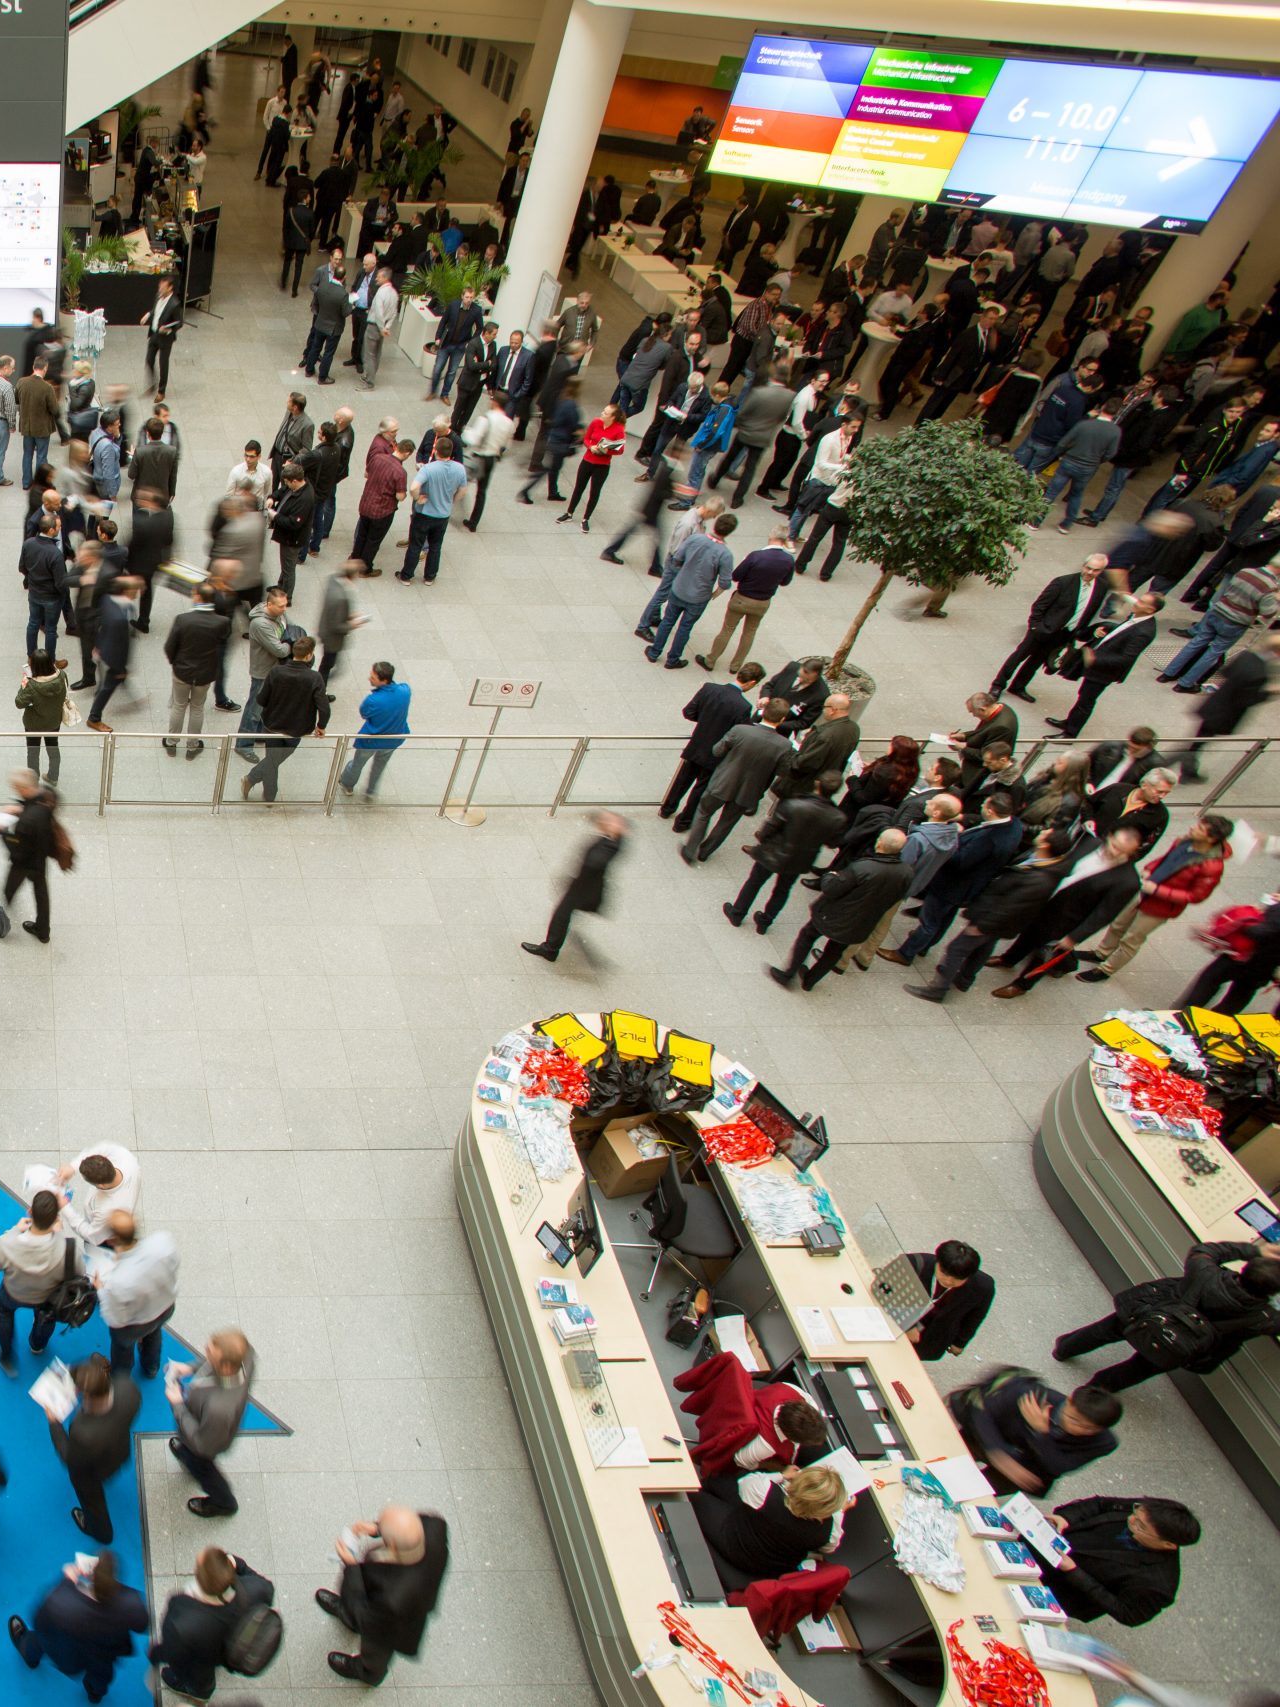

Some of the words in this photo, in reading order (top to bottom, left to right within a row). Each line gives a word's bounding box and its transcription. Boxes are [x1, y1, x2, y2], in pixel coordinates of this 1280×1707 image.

[860, 95, 898, 106] Industrielle
[898, 99, 952, 111] Kommunikation
[857, 105, 885, 114] Industrial
[885, 108, 933, 119] communication
[1008, 97, 1029, 122] 6
[1058, 101, 1118, 131] 10.0
[1024, 135, 1082, 163] 11.0
[831, 163, 886, 177] Interfacetechnik
[561, 1031, 586, 1047] PILZ
[620, 1031, 646, 1043] PILZ
[1115, 1037, 1142, 1049] PILZ
[675, 1053, 703, 1067] PILZ
